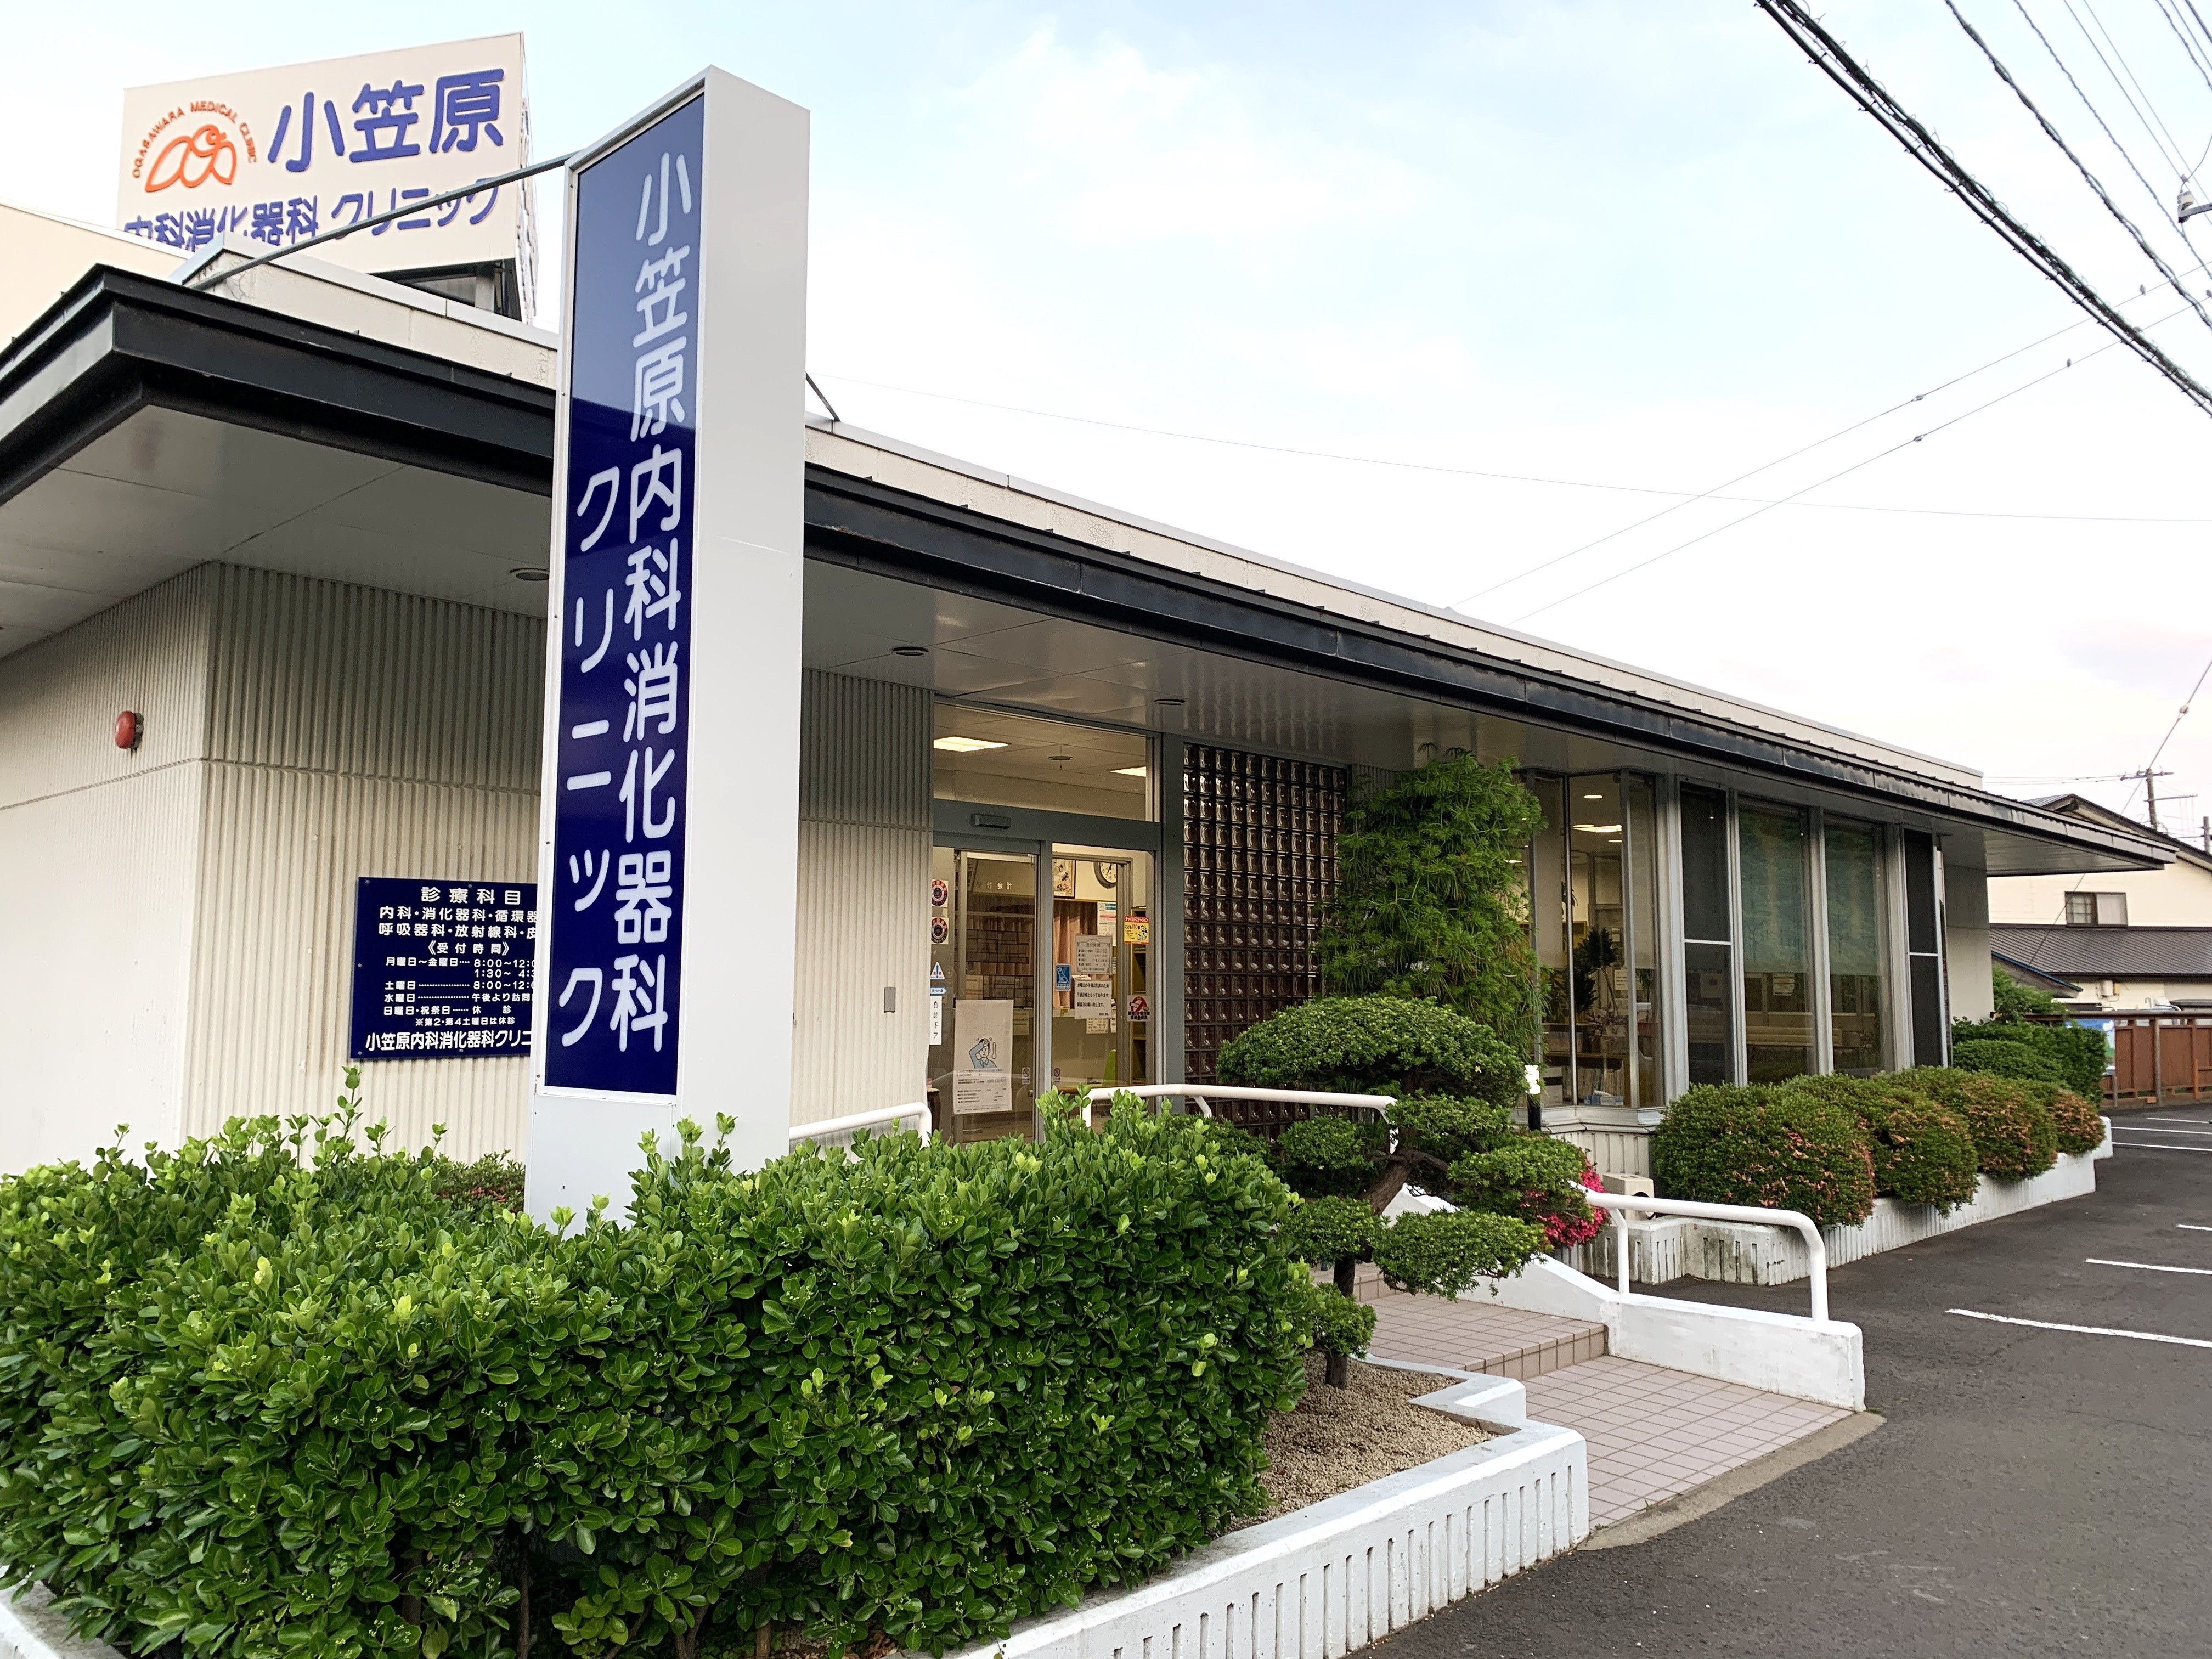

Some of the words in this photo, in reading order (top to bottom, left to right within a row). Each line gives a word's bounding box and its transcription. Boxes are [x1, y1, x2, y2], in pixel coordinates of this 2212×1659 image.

[132, 106, 185, 178] OGASAWARA
[190, 101, 238, 124] MEDICAL
[239, 122, 257, 163] CLINIC
[267, 68, 504, 172] 小笠原
[609, 151, 692, 1052] 小笠原内科消化器科
[558, 466, 620, 1047] クリニック
[421, 887, 521, 905] 診療科目
[977, 881, 1012, 890] 付会計
[472, 993, 533, 1002] 午後より訪問
